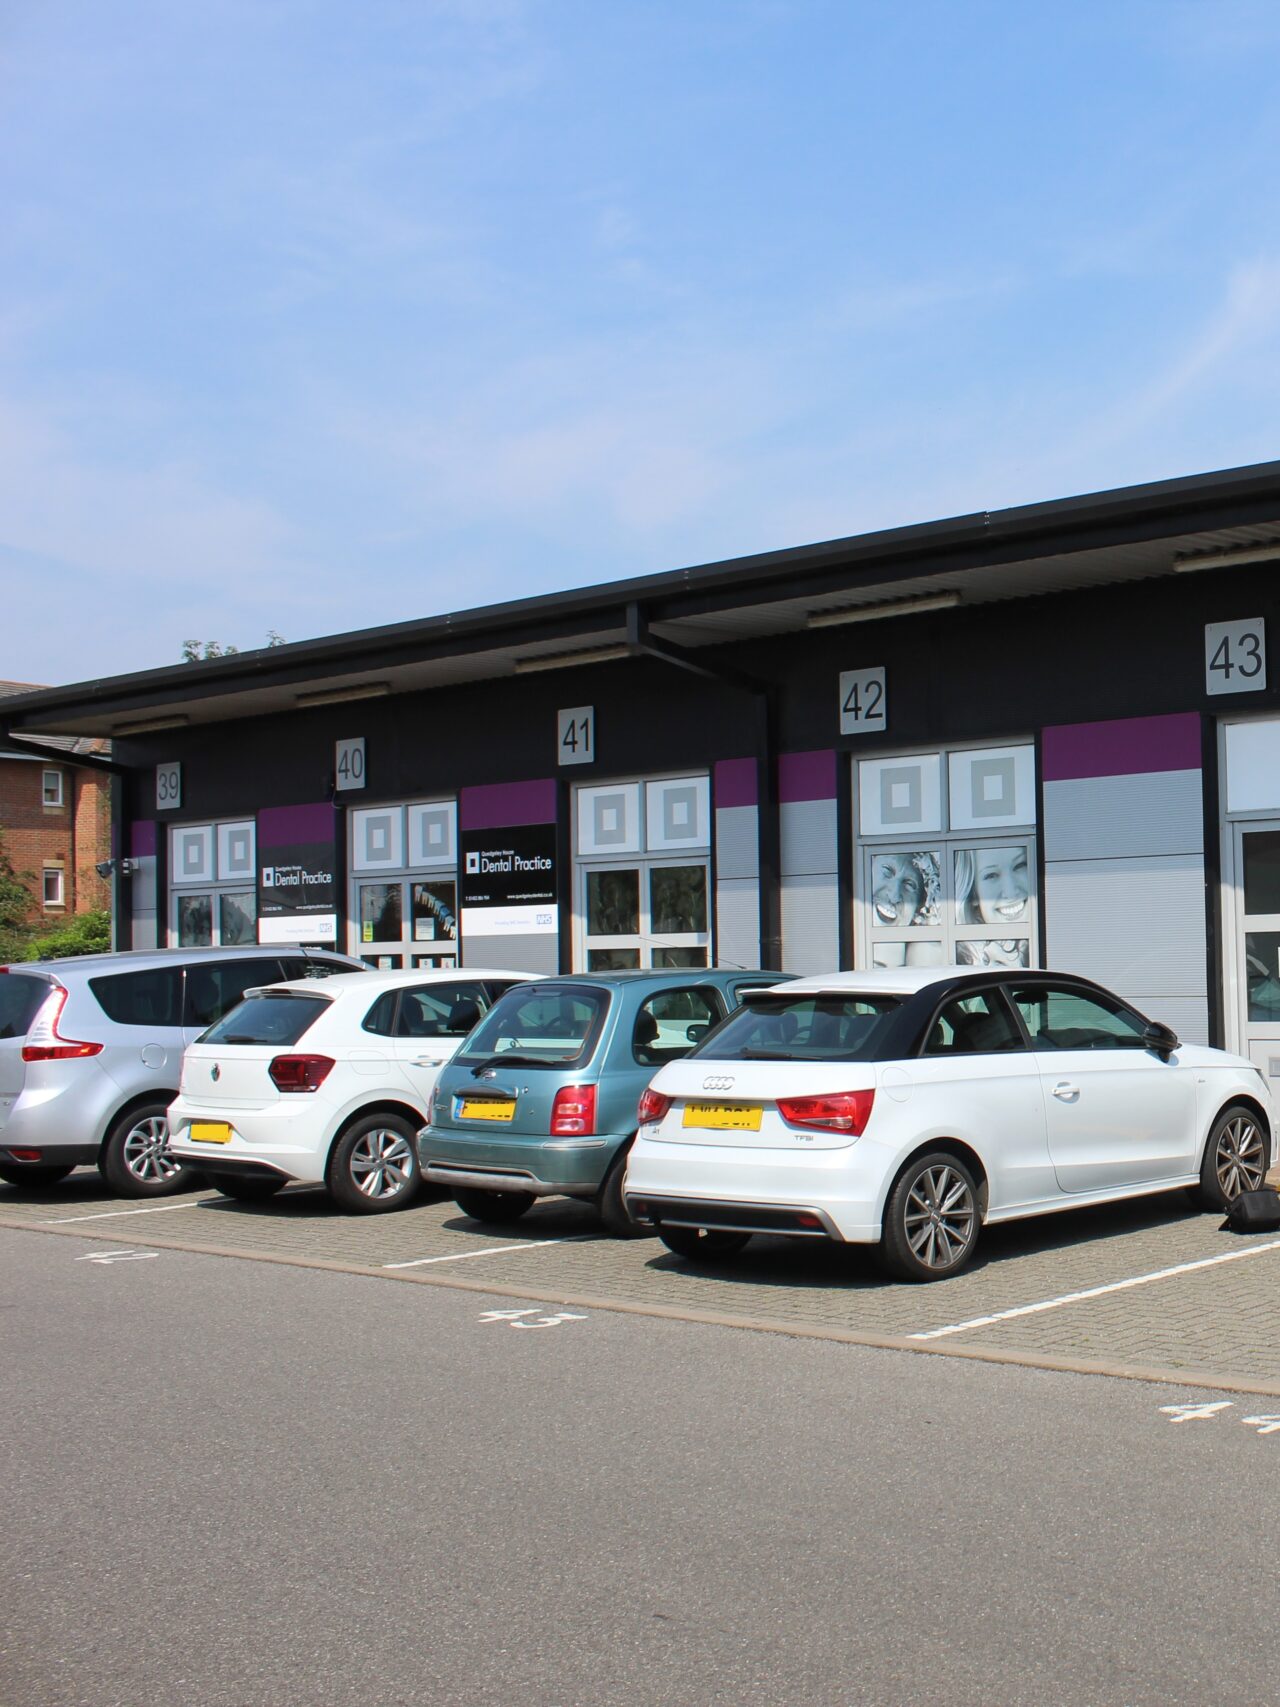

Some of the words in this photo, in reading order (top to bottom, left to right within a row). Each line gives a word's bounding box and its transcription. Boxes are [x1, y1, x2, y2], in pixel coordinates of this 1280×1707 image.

[1209, 632, 1262, 680] 43
[843, 680, 884, 721] 42
[562, 717, 589, 753] 41
[338, 748, 363, 779] 40
[158, 771, 180, 800] 39
[275, 871, 300, 886] Dental
[301, 871, 332, 885] Practice
[481, 856, 512, 873] Dental
[514, 856, 552, 871] Practice
[479, 1309, 588, 1328] 43
